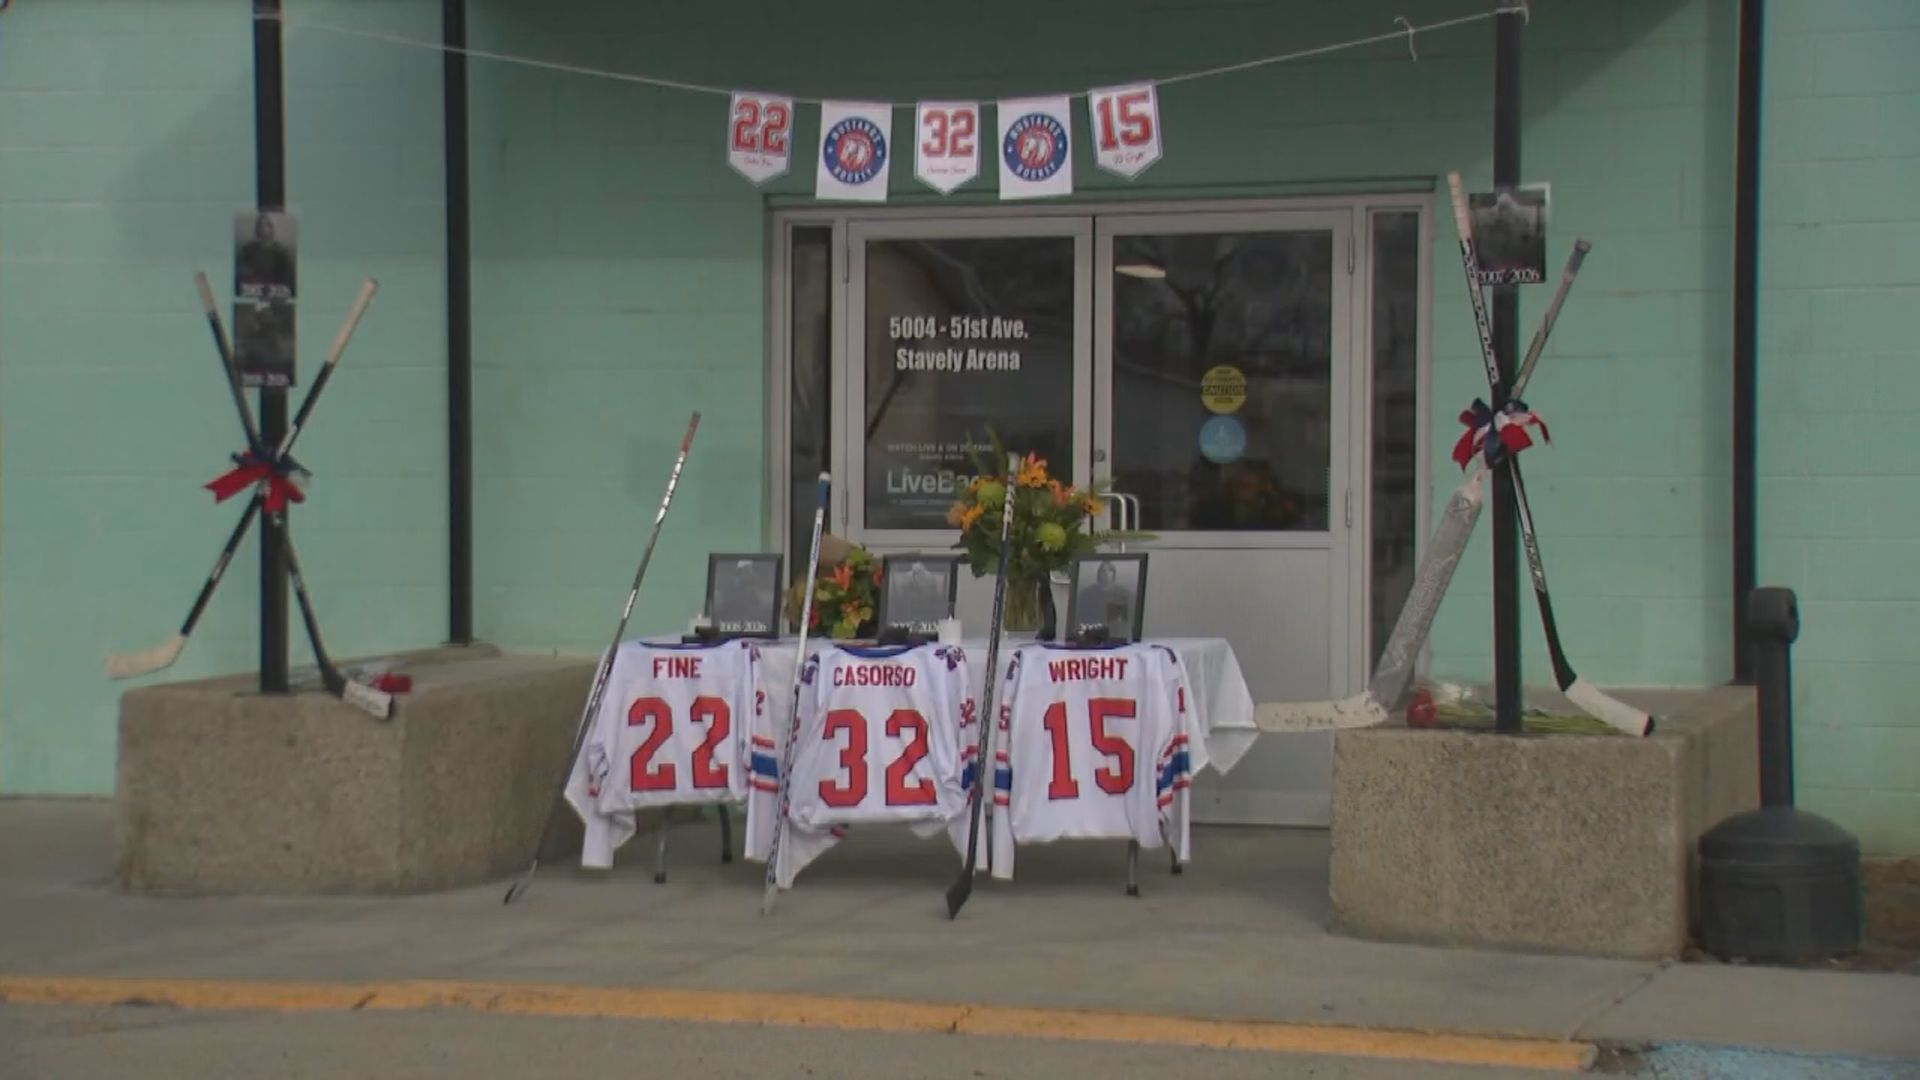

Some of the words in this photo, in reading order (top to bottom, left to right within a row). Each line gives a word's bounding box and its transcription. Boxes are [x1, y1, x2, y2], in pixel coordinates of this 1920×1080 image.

[732, 97, 789, 157] 22
[831, 119, 881, 143] MUSTANGS
[922, 108, 974, 158] 32
[1009, 115, 1060, 140] MUSTANGS
[1096, 90, 1153, 151] 15
[834, 168, 873, 183] HOCKEY
[1016, 162, 1057, 180] HOCKEY
[889, 316, 937, 339] 5004
[950, 316, 988, 339] 51st
[991, 316, 1029, 339] Ave.
[896, 348, 964, 372] Stavely
[966, 348, 1021, 371] Arena
[652, 656, 703, 679] FINE
[832, 664, 917, 687] CASORSO
[1048, 656, 1129, 683] WRIGHT
[628, 695, 731, 793] 22
[1043, 697, 1137, 801] 15
[818, 708, 938, 808] 32
